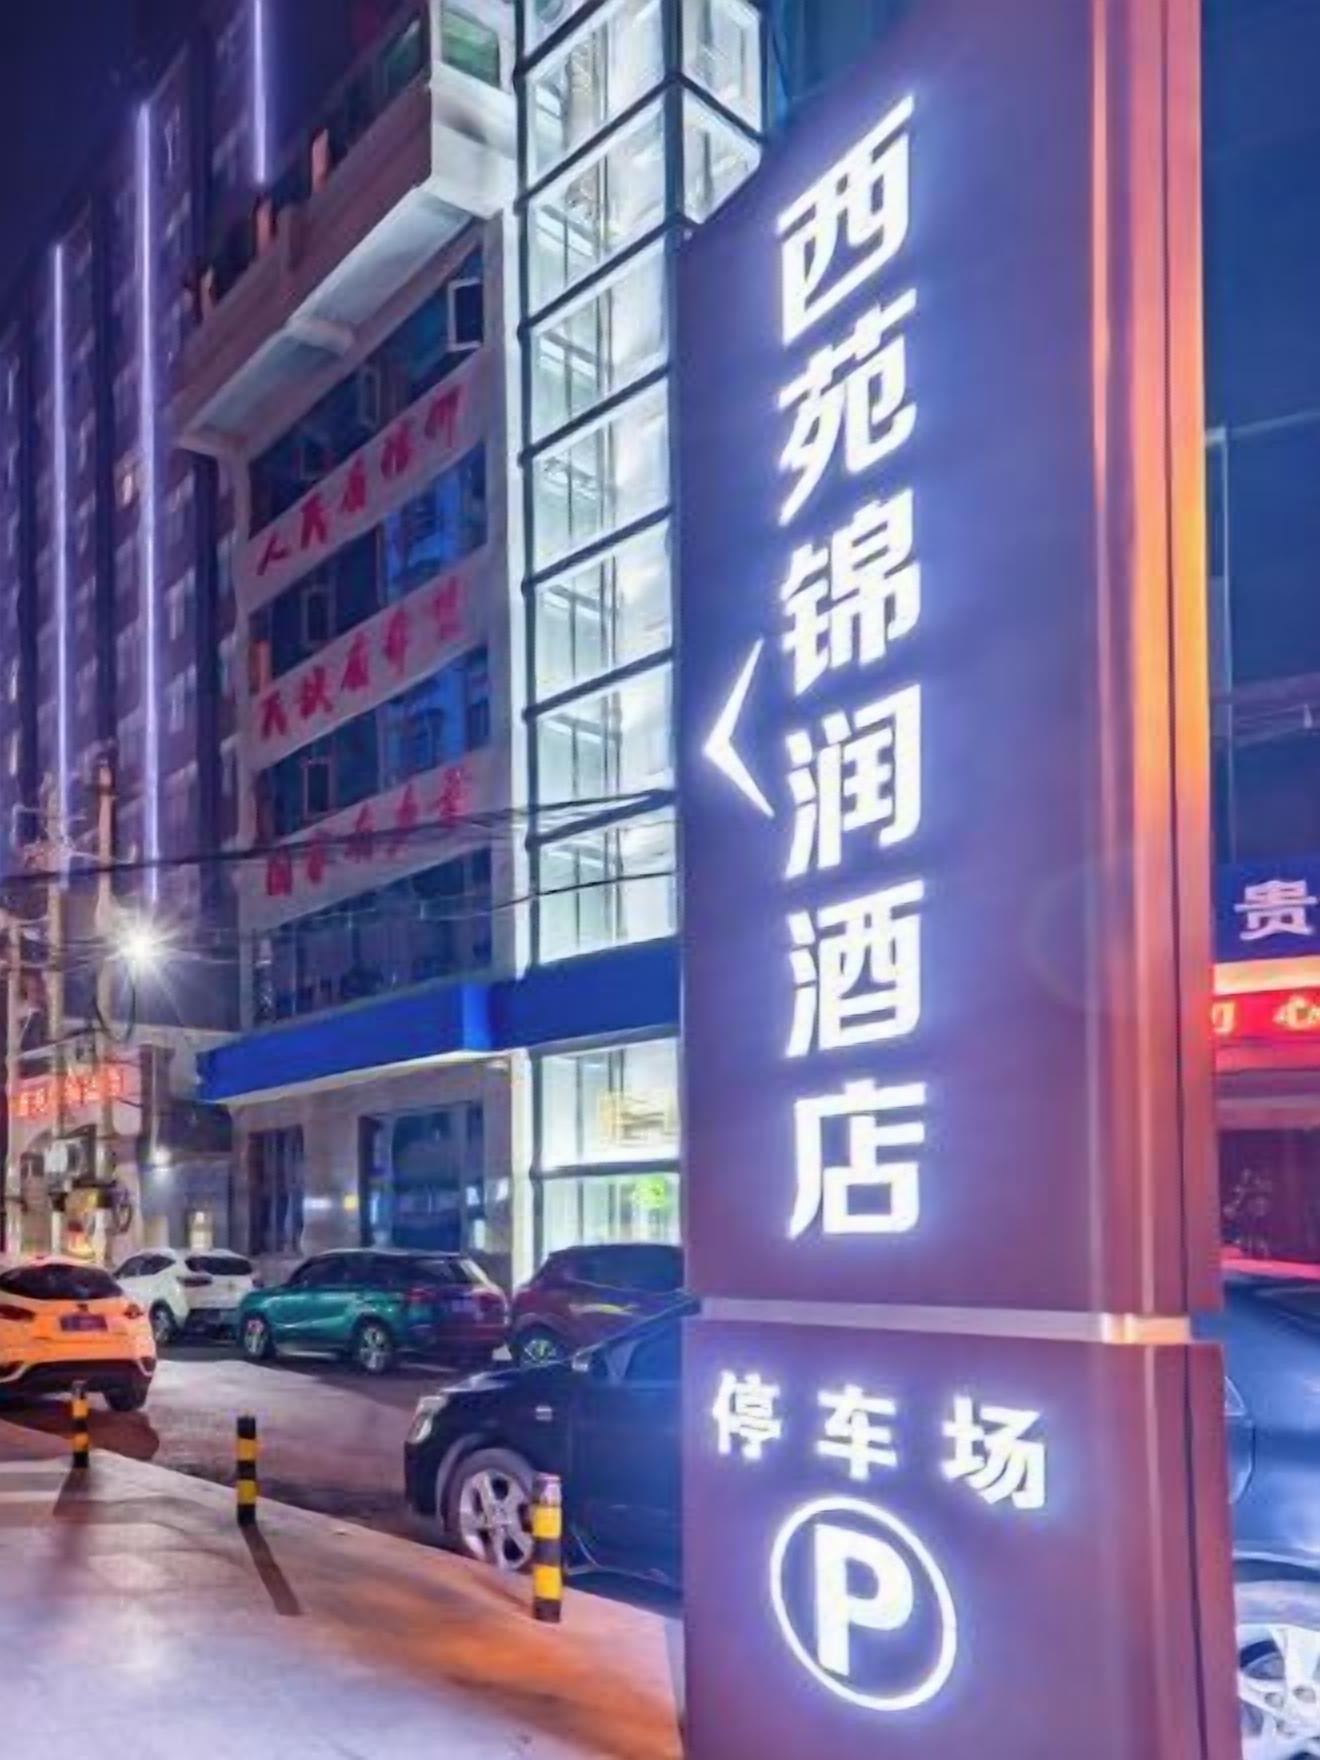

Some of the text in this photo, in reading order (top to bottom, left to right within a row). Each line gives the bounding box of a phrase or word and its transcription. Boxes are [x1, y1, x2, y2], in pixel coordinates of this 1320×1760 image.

[778, 94, 926, 1240] 西苑锦润酒店
[1234, 879, 1318, 940] 贵
[712, 1370, 1047, 1510] 停车场
[814, 1523, 914, 1677] P
